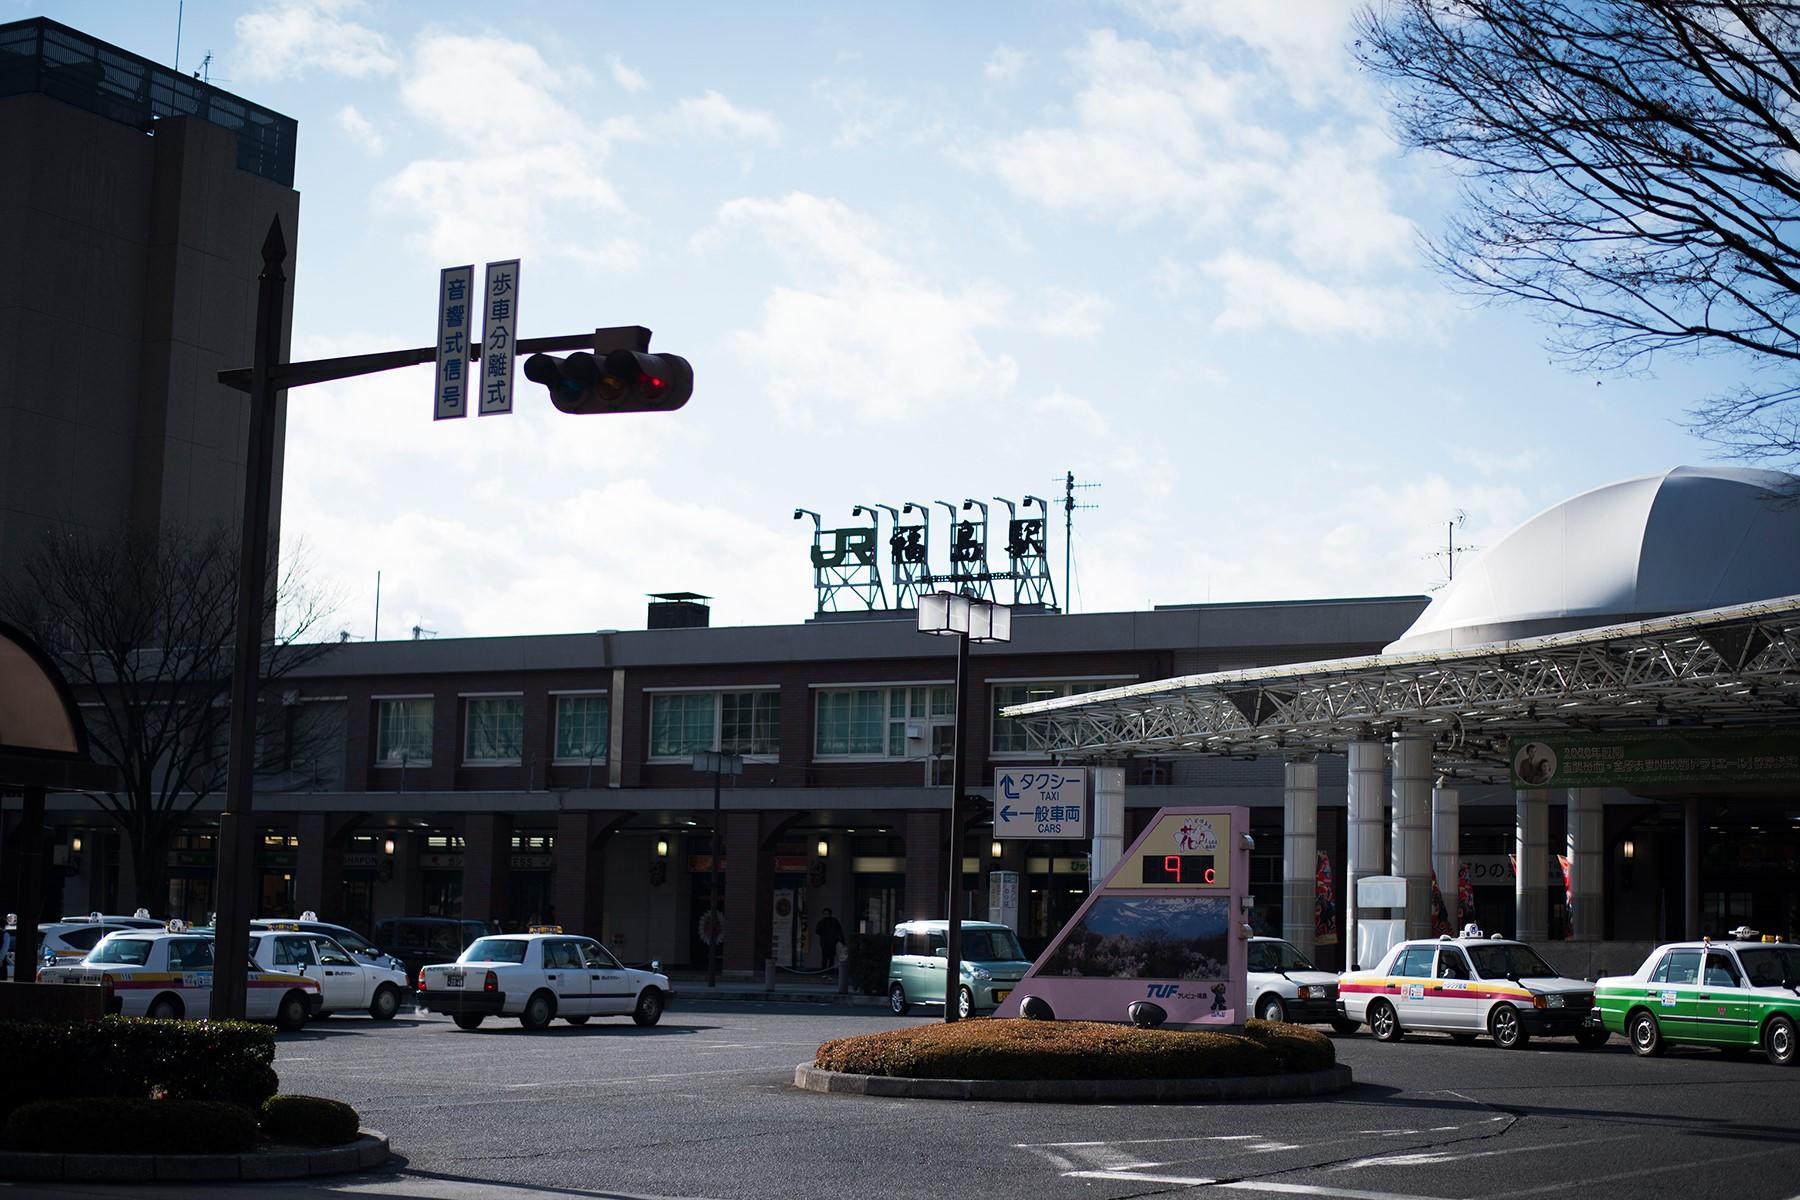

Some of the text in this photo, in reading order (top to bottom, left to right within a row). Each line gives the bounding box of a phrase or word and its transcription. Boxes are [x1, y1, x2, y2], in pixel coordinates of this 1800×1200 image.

[442, 278, 466, 408] 音響式信号
[487, 273, 512, 404] 歩車分離式
[811, 527, 874, 567] JR
[1020, 774, 1081, 790] タクシー
[1040, 791, 1060, 801] TAXI
[1019, 805, 1080, 822] 一般車両
[1037, 824, 1061, 833] CARS
[1164, 856, 1181, 883] 9
[1147, 984, 1179, 998] TUF
